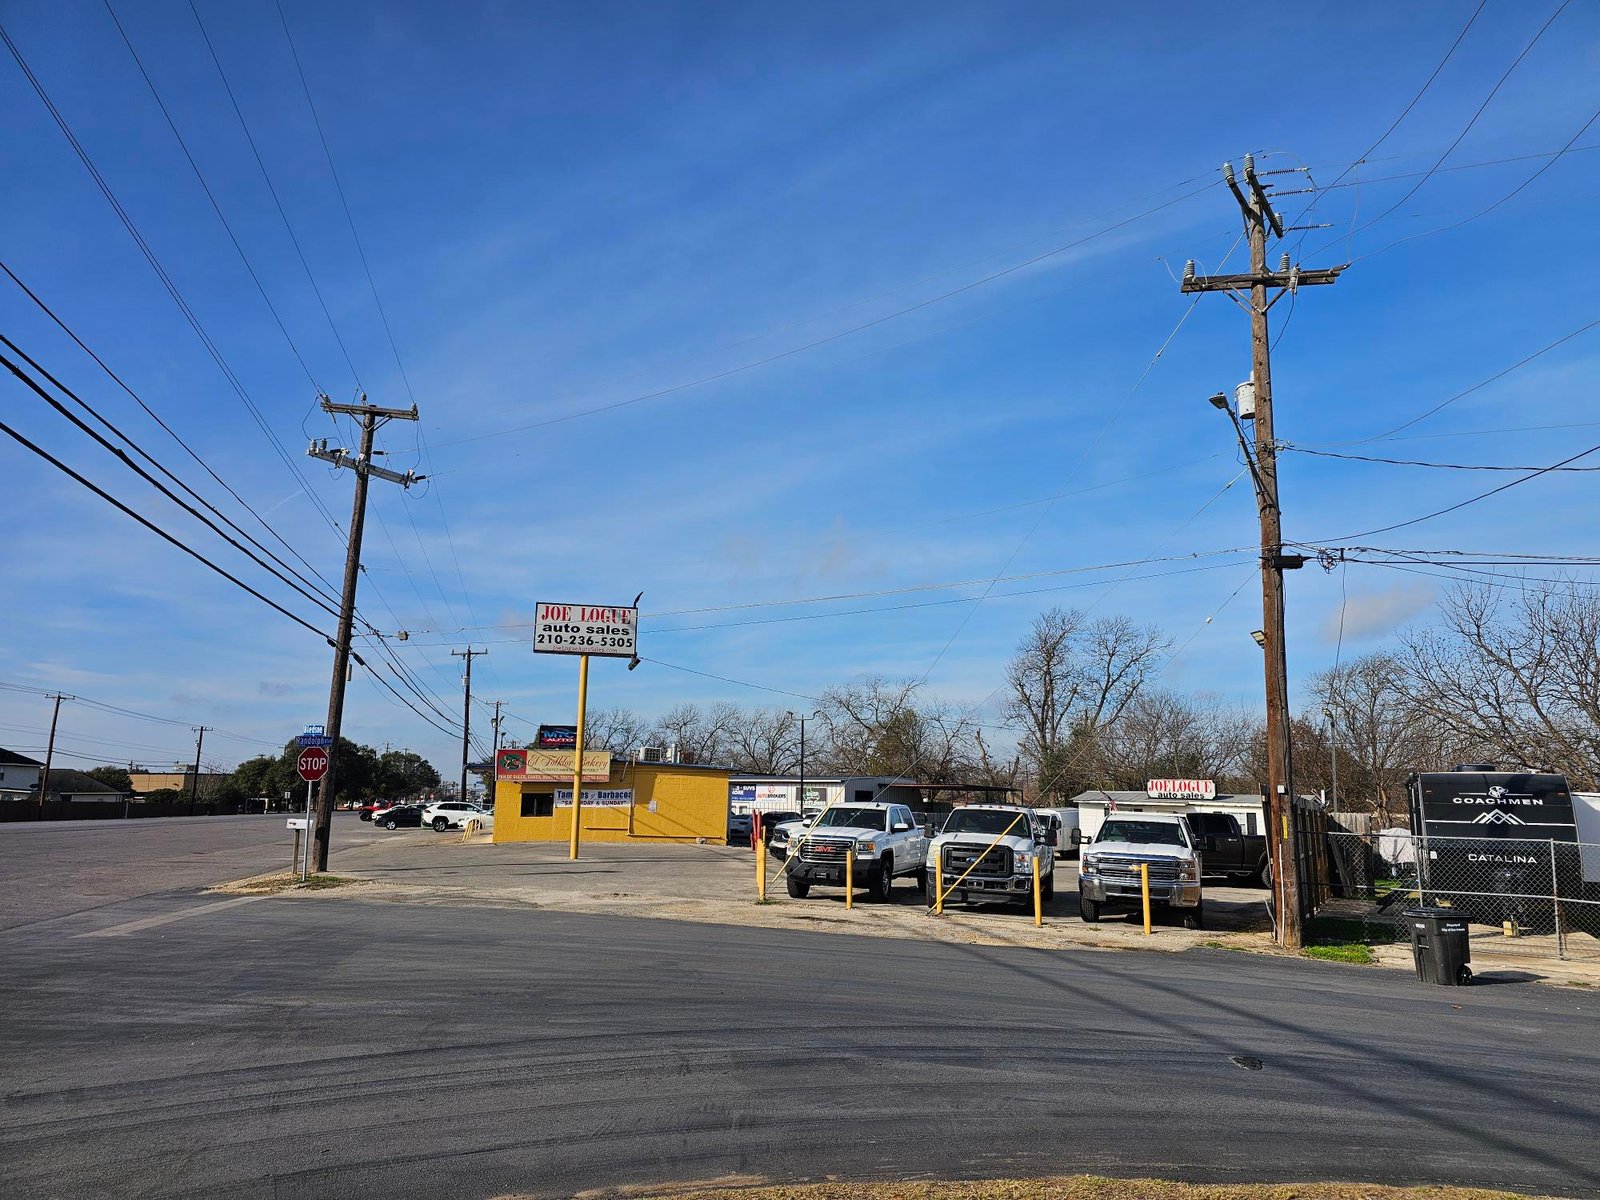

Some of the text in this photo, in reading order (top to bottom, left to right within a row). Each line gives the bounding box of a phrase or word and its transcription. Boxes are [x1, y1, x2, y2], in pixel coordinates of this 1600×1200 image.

[541, 605, 631, 624] JOE LOGUE
[542, 624, 630, 636] auto sales
[537, 634, 632, 648] 210-236-5305
[300, 757, 326, 770] STOP
[1148, 780, 1212, 793] JOE LOGUE
[557, 790, 589, 799] Tames
[1468, 854, 1537, 864] CATALINA
